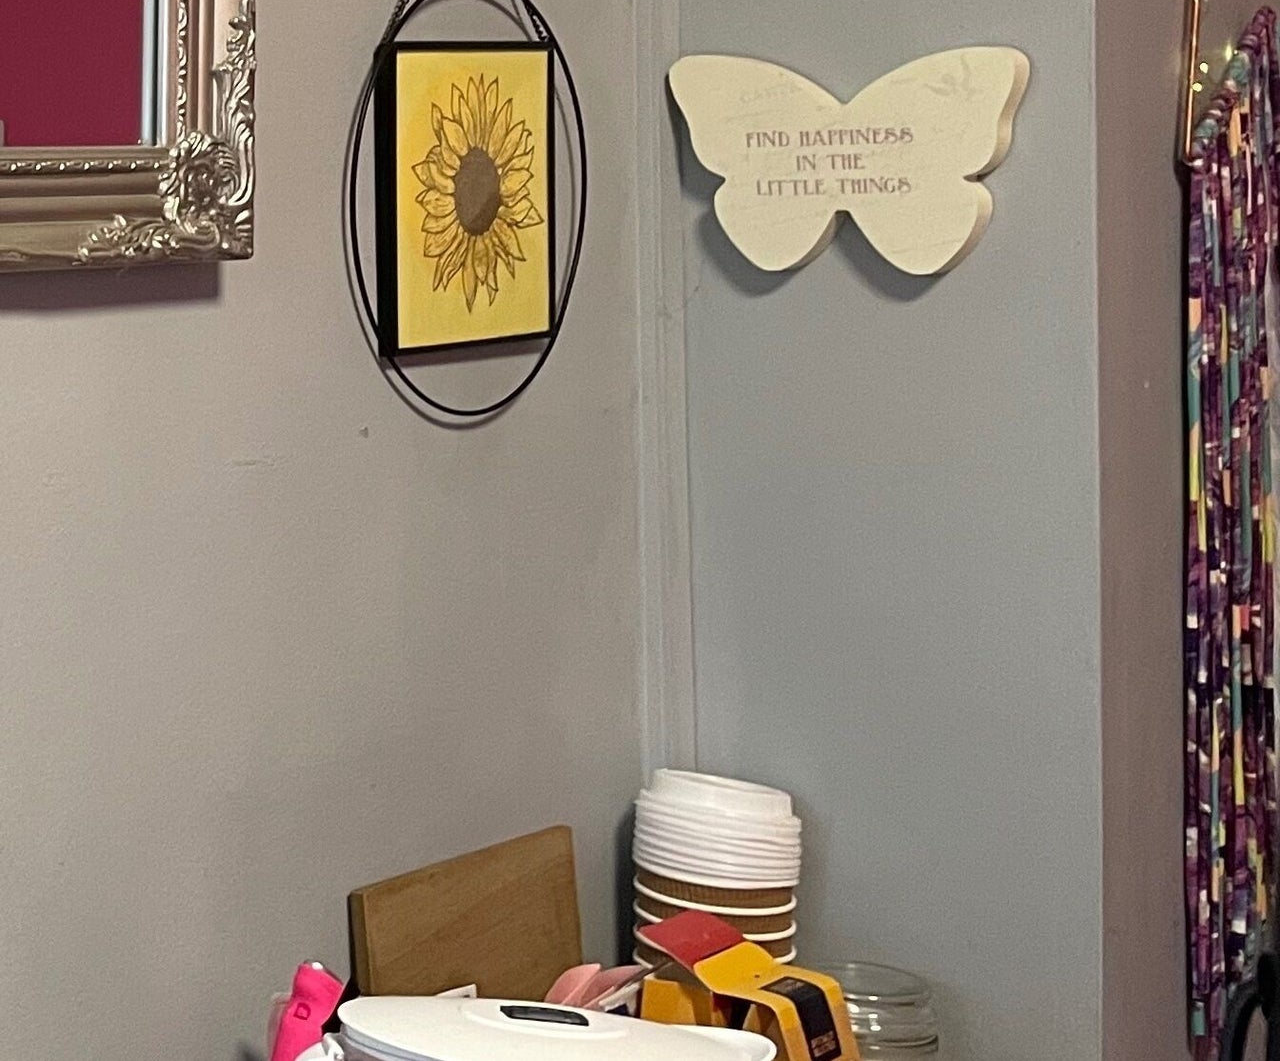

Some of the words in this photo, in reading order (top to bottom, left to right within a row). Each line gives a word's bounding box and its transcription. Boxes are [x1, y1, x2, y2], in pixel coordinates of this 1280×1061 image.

[745, 130, 790, 148] FIND
[799, 127, 914, 147] HAPPINESS
[795, 154, 817, 171] IN
[826, 153, 866, 170] THE
[756, 178, 827, 196] LITTLE
[835, 176, 912, 195] THINGS
